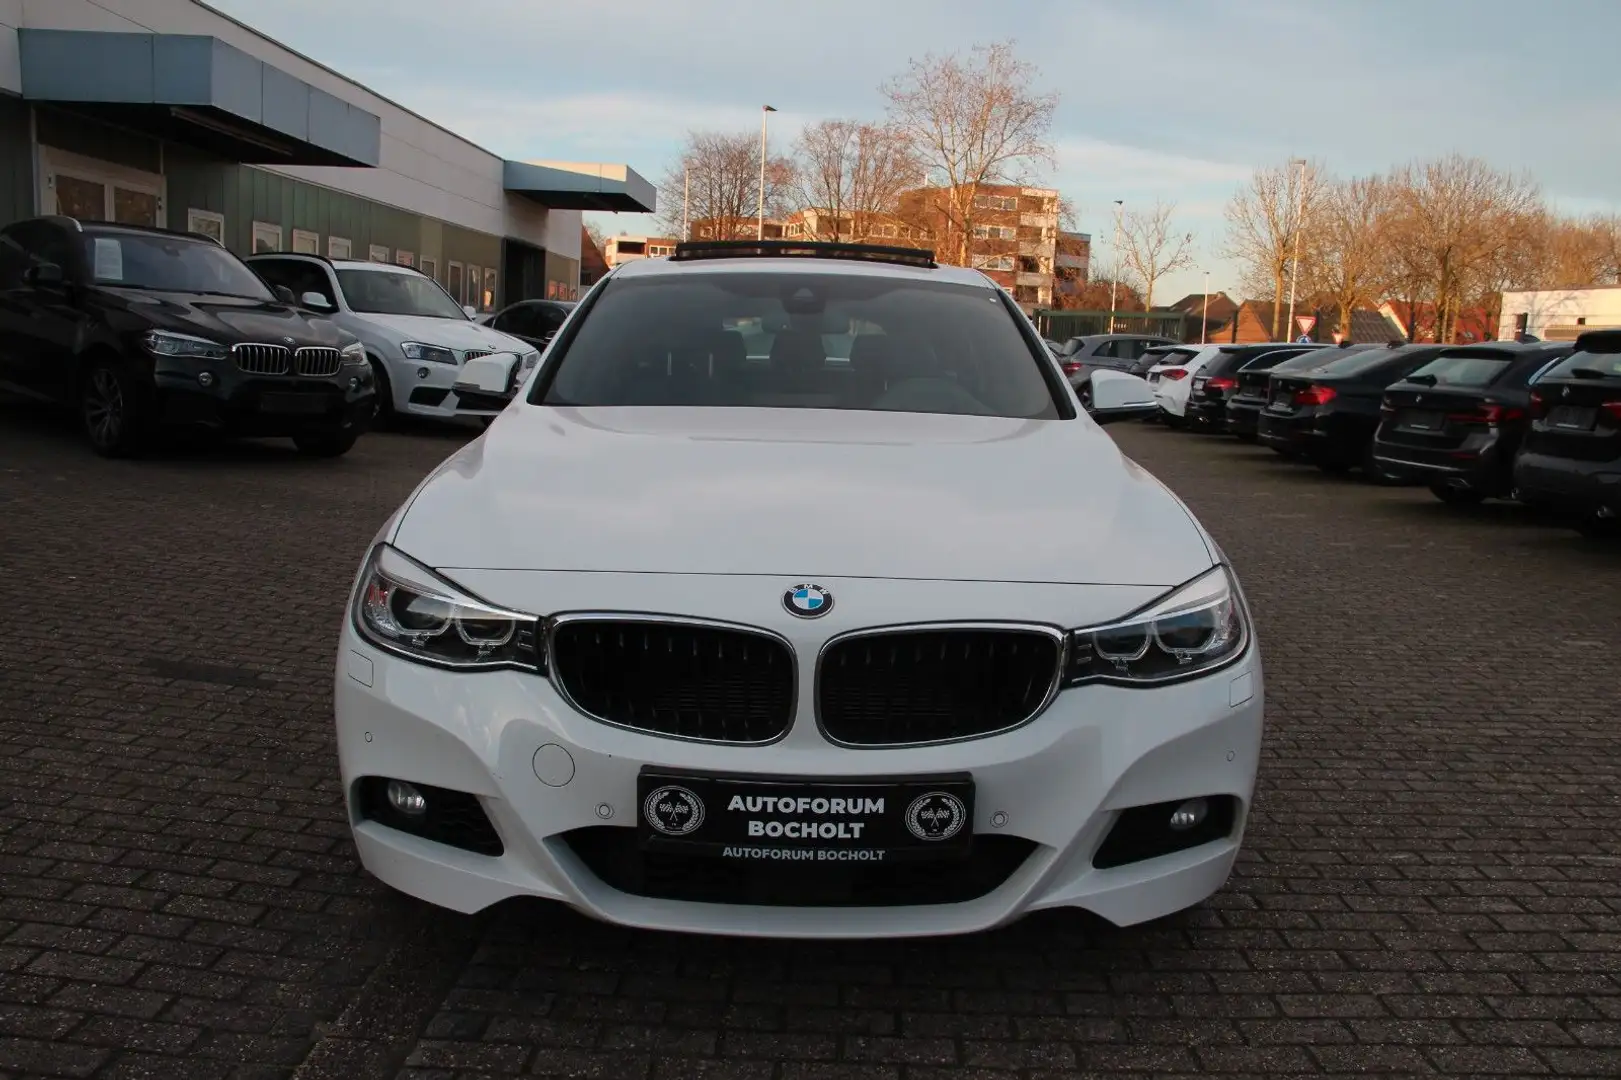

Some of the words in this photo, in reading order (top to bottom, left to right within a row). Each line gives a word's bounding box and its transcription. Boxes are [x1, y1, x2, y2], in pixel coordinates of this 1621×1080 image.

[727, 795, 885, 815] AUTOFORUM
[748, 820, 865, 839] BOCHOLT
[722, 846, 814, 861] AUTOFORUM
[817, 849, 886, 861] BOCHOLT
